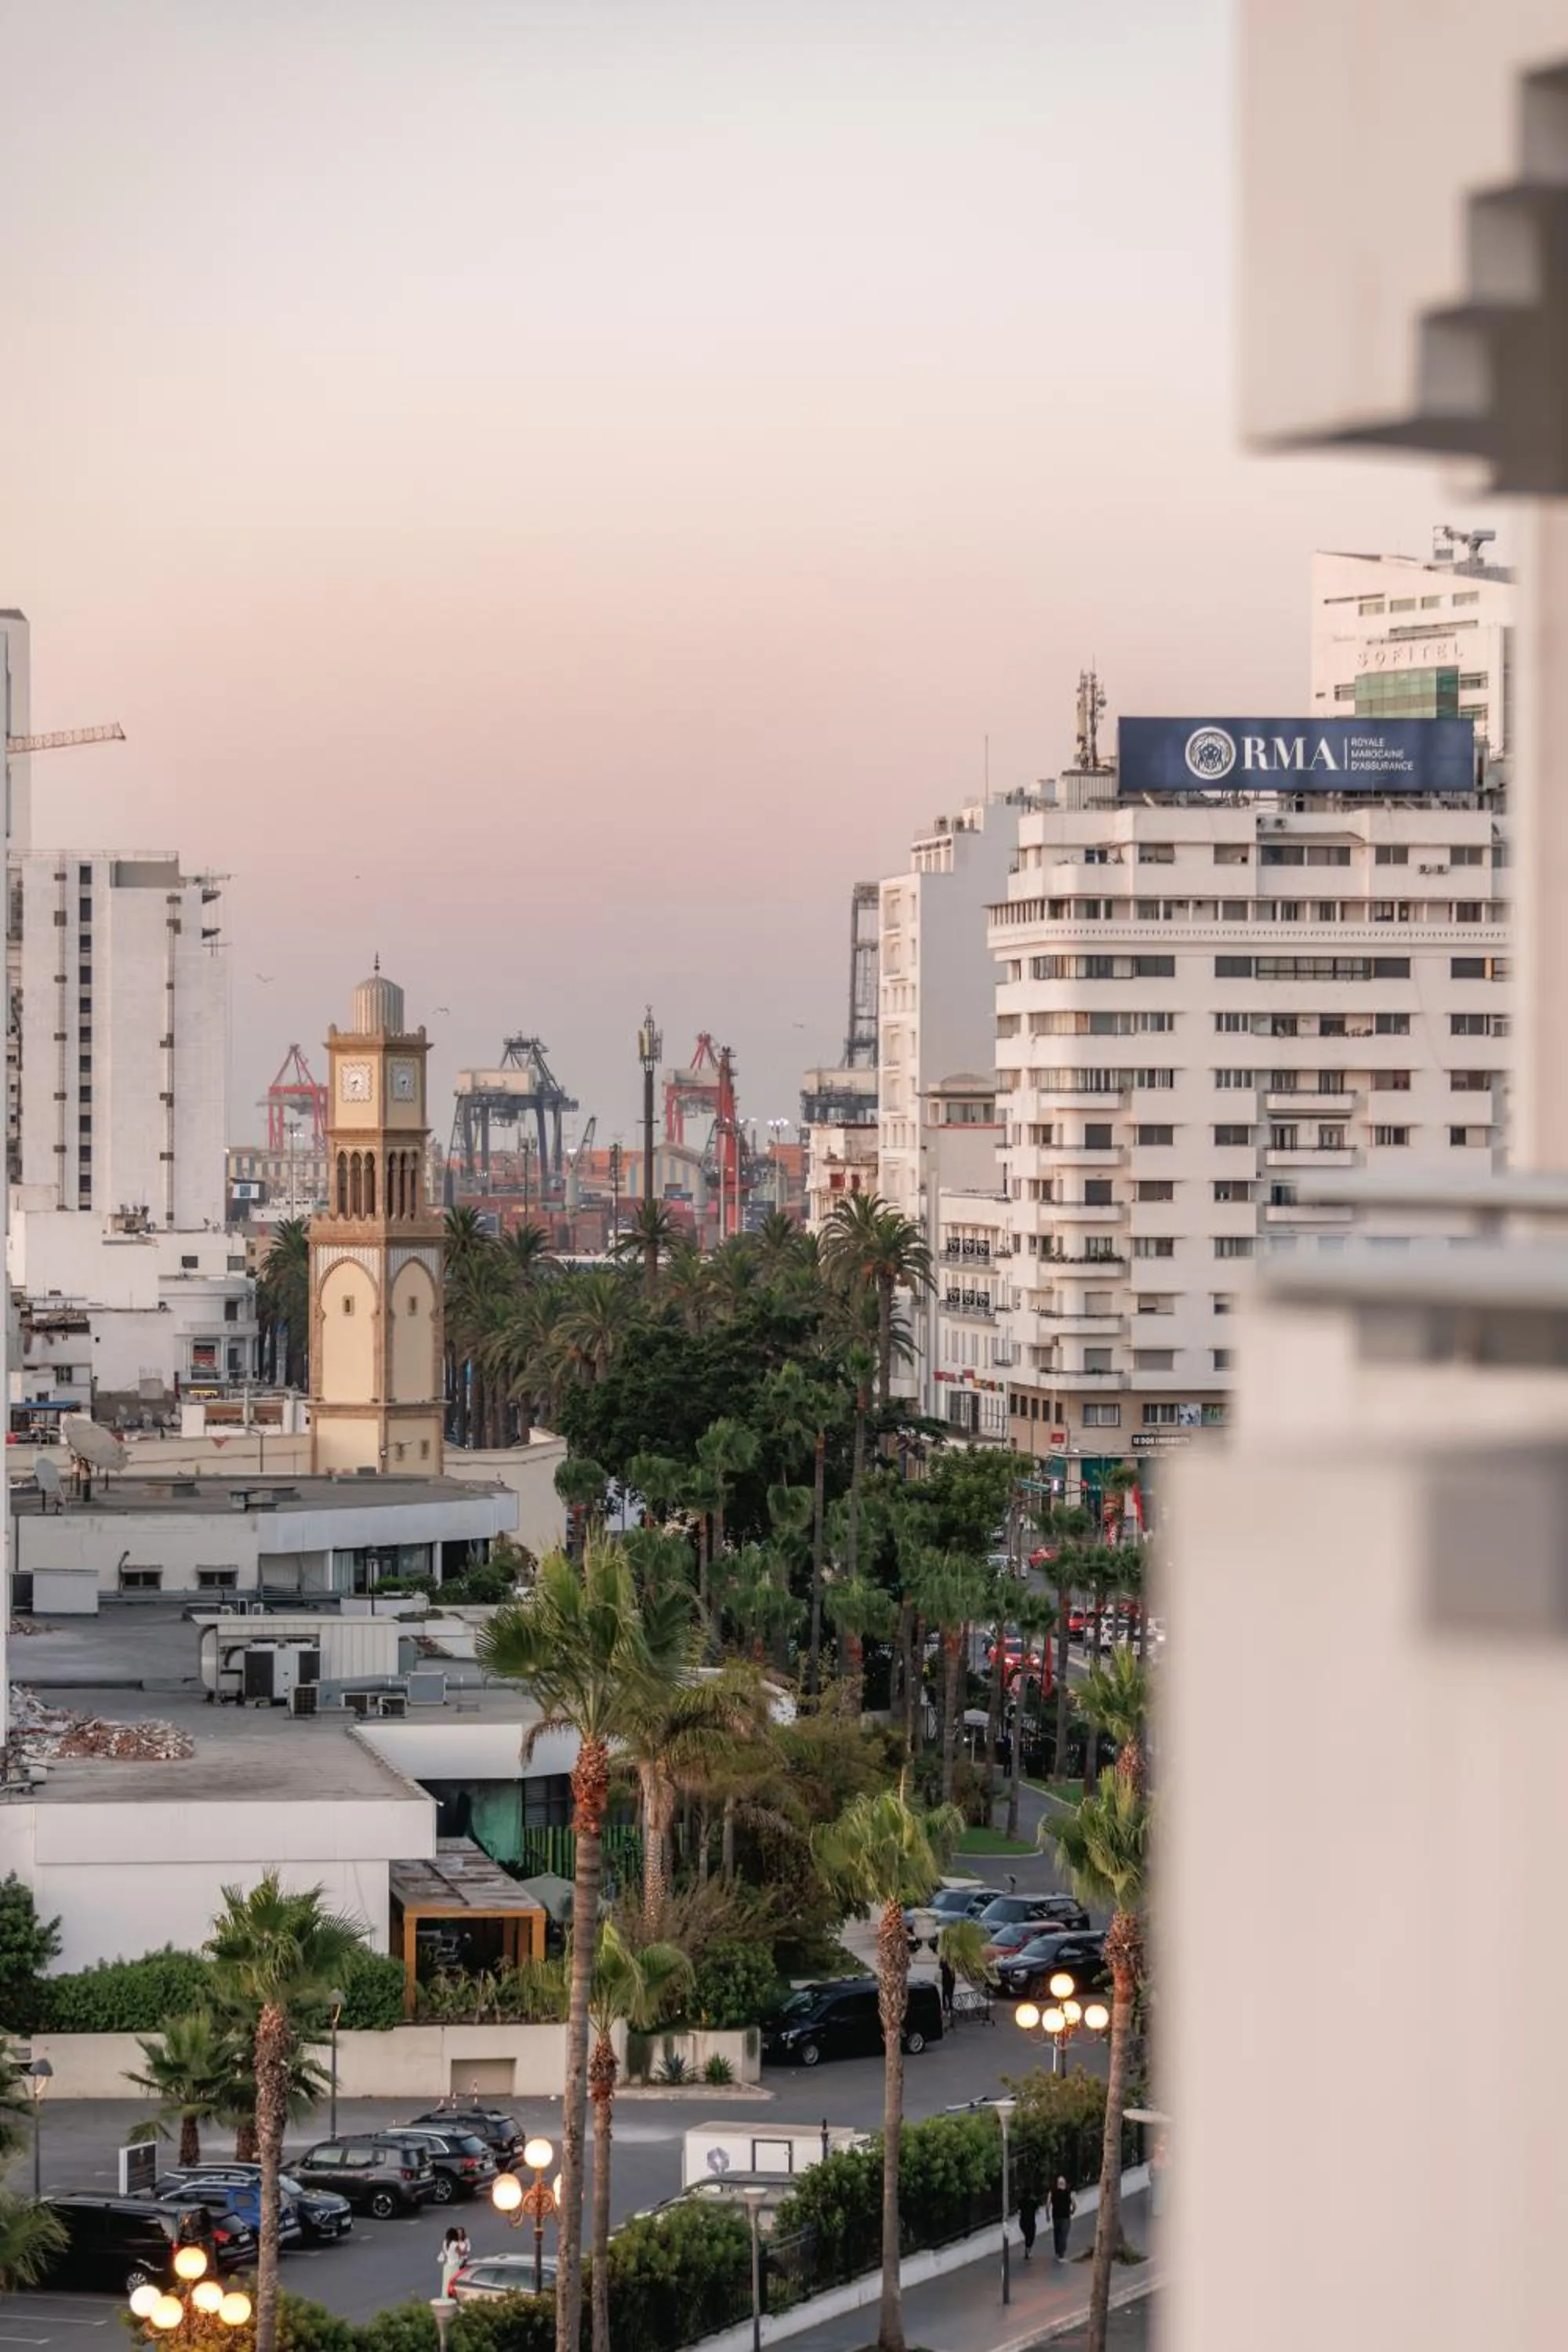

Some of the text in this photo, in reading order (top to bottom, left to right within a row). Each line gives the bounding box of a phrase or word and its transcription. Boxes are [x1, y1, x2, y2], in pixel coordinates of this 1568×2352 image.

[1357, 641, 1465, 666] SOFITEL
[1350, 737, 1385, 747] ROYALE
[1242, 736, 1341, 771] RMA
[1350, 748, 1404, 759] MAROCAINE
[1350, 760, 1414, 771] D'ASSURANCE
